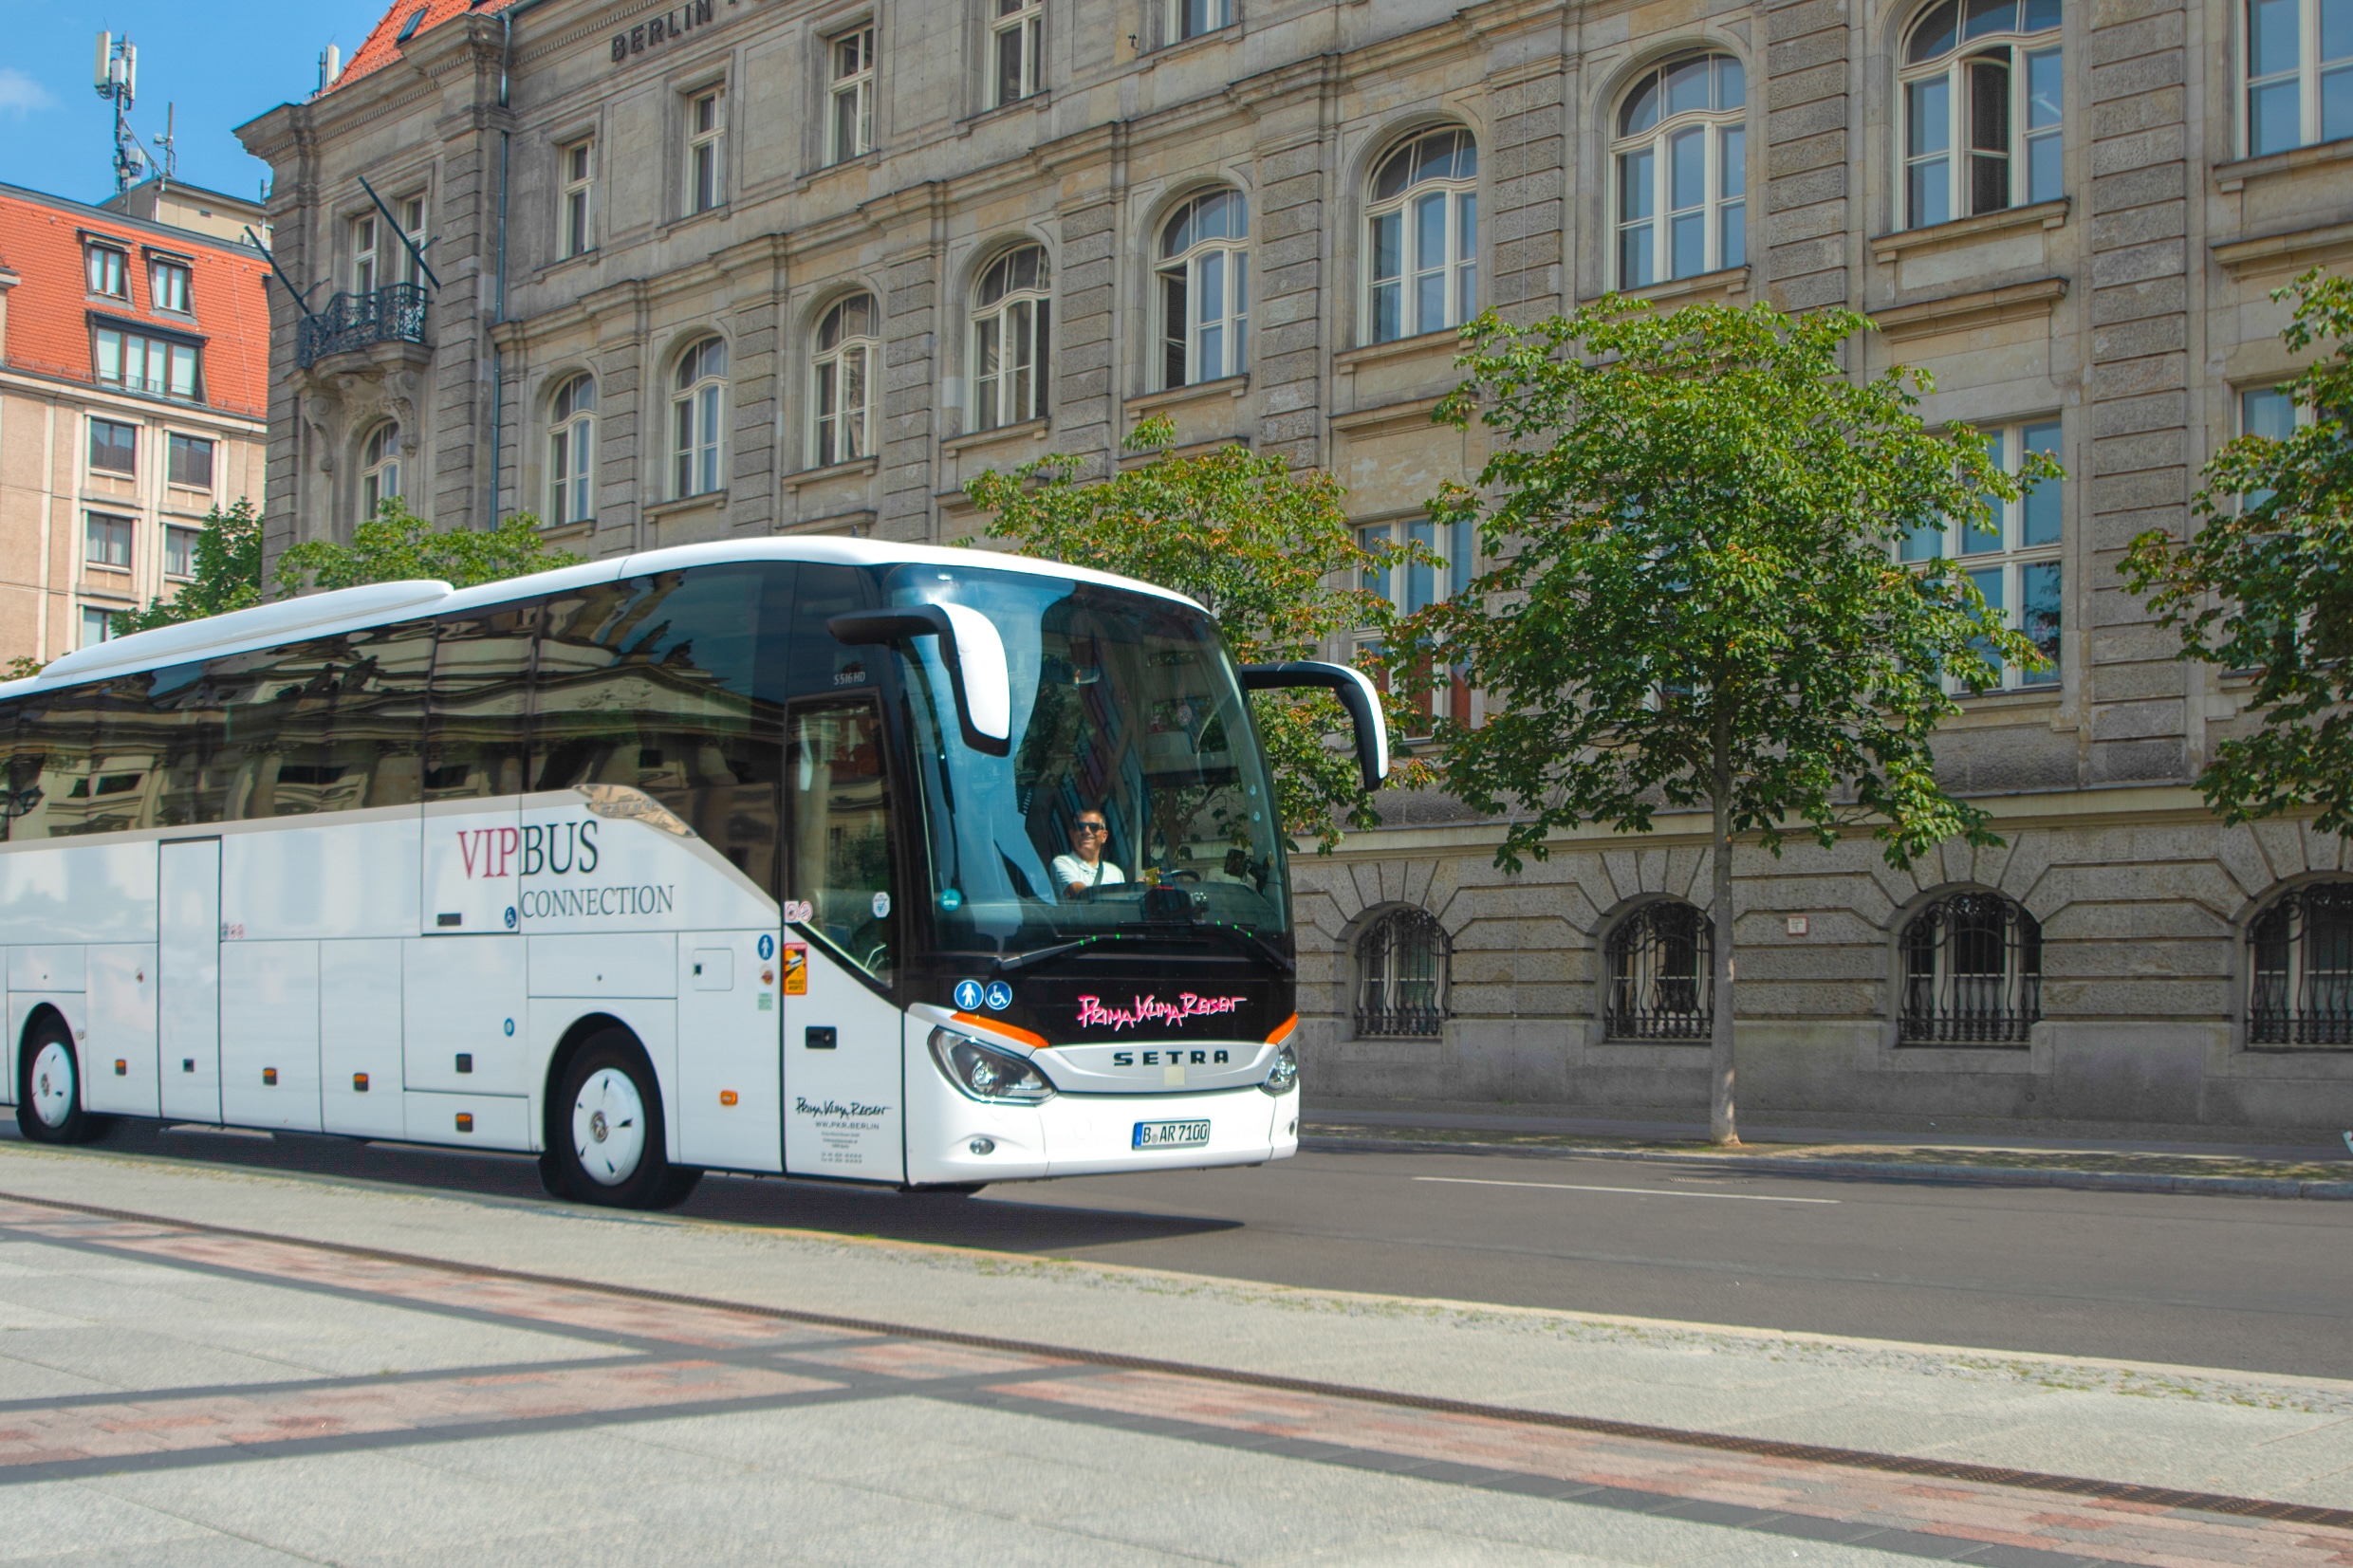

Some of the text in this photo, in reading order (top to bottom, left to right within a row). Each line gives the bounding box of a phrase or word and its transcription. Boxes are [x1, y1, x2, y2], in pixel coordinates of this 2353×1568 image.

[611, 0, 713, 63] BERLIN
[521, 885, 675, 918] CONNECTION
[1113, 1049, 1230, 1067] SETRA
[1159, 1125, 1176, 1143] AR
[1178, 1123, 1208, 1142] 7100
